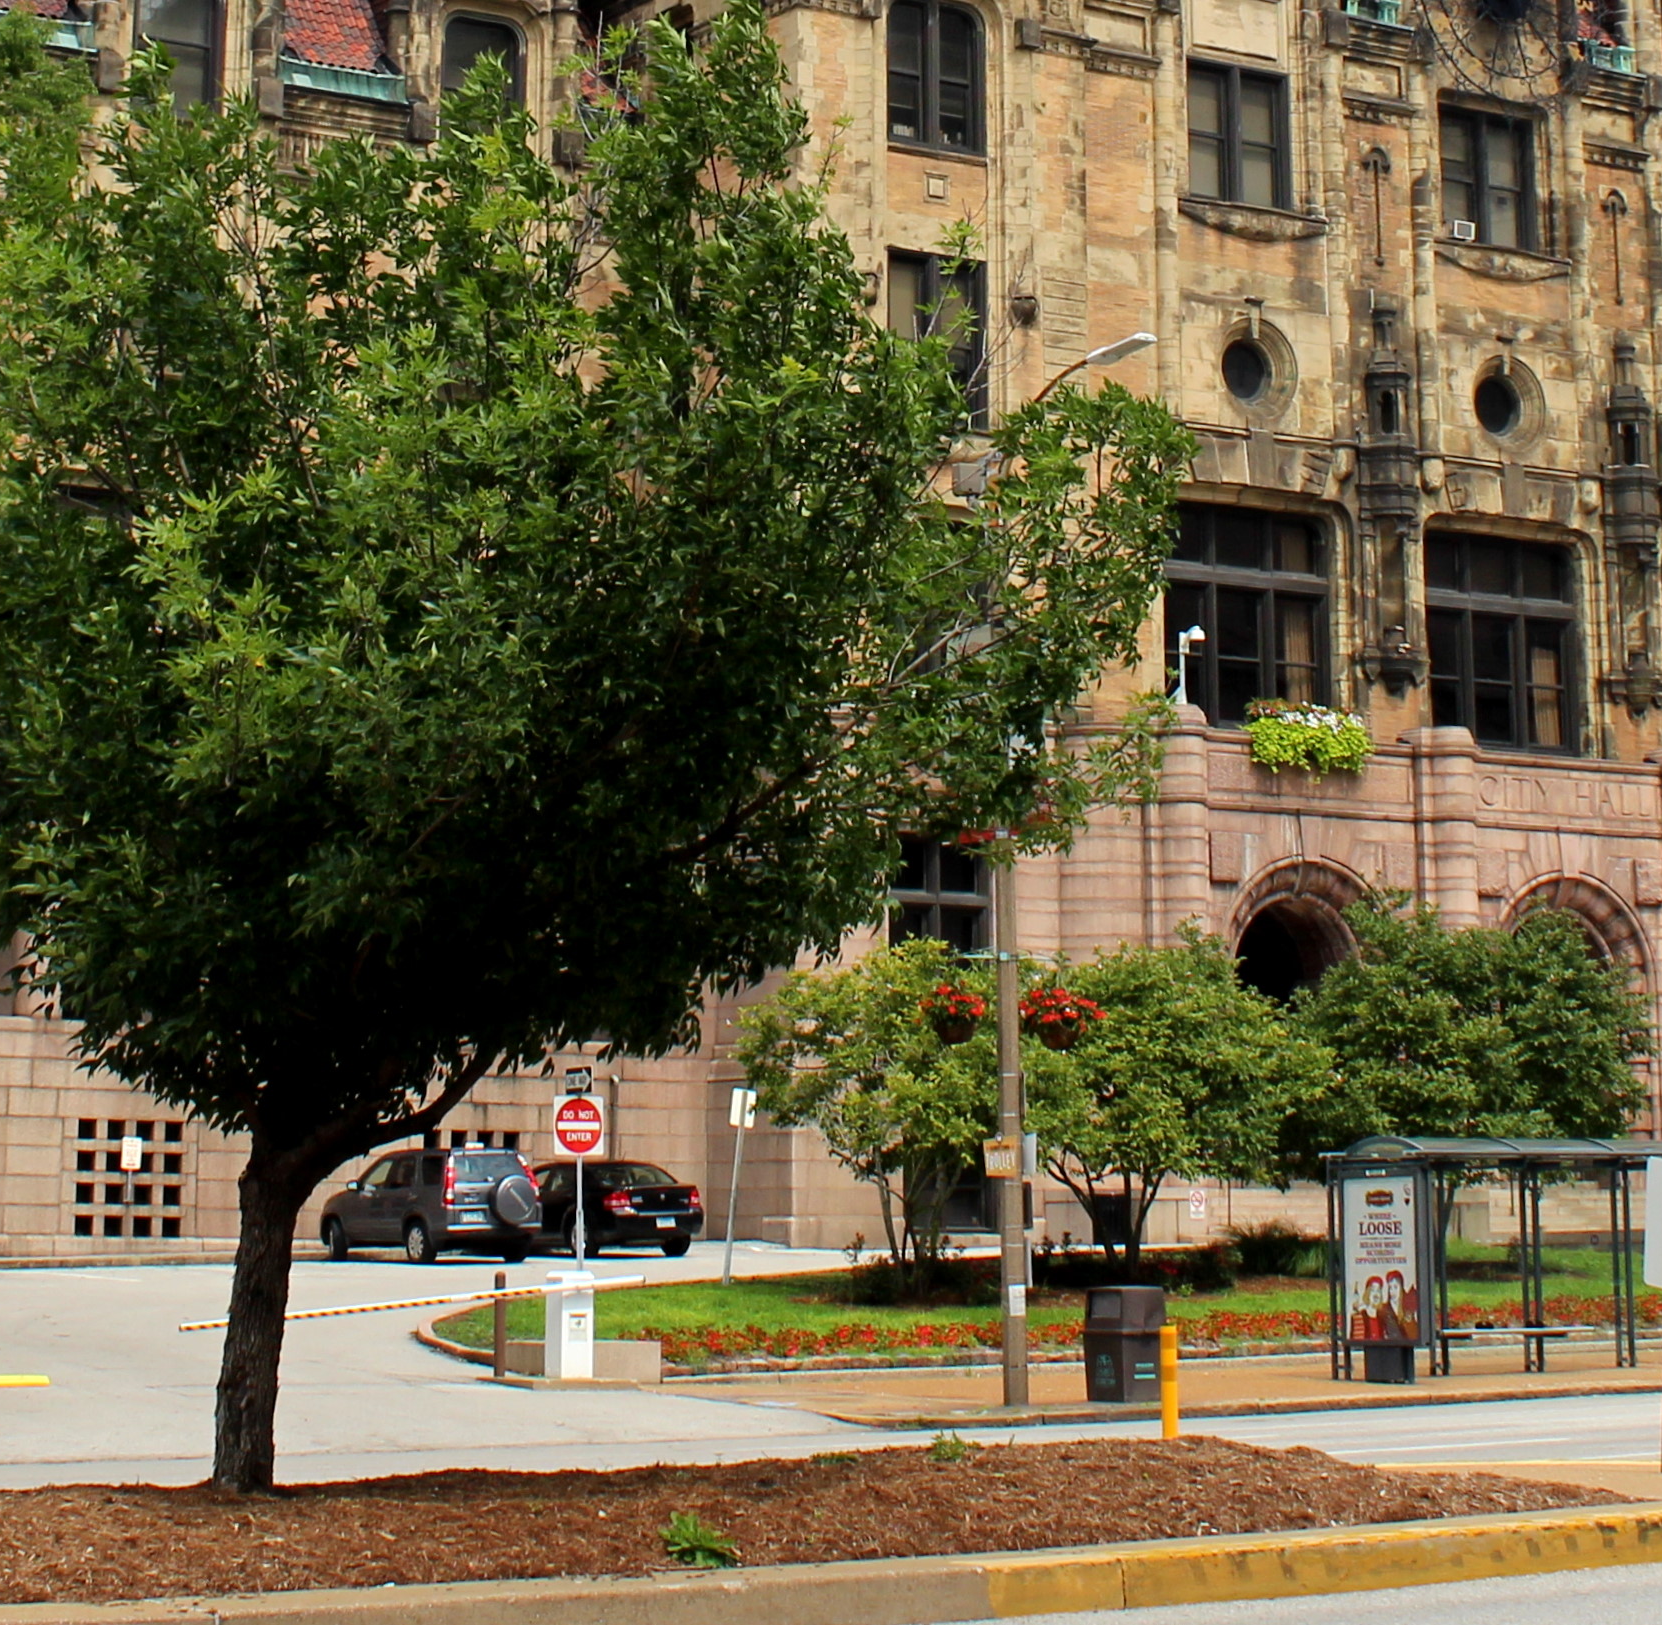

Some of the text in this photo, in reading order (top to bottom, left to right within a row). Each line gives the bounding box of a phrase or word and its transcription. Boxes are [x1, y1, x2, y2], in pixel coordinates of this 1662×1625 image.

[1479, 775, 1651, 817] CITY HALL
[562, 1109, 594, 1120] DO NOT
[566, 1132, 592, 1142] ENTER
[985, 1151, 1016, 1170] TROLLEY
[1359, 1221, 1403, 1236] LOOSE
